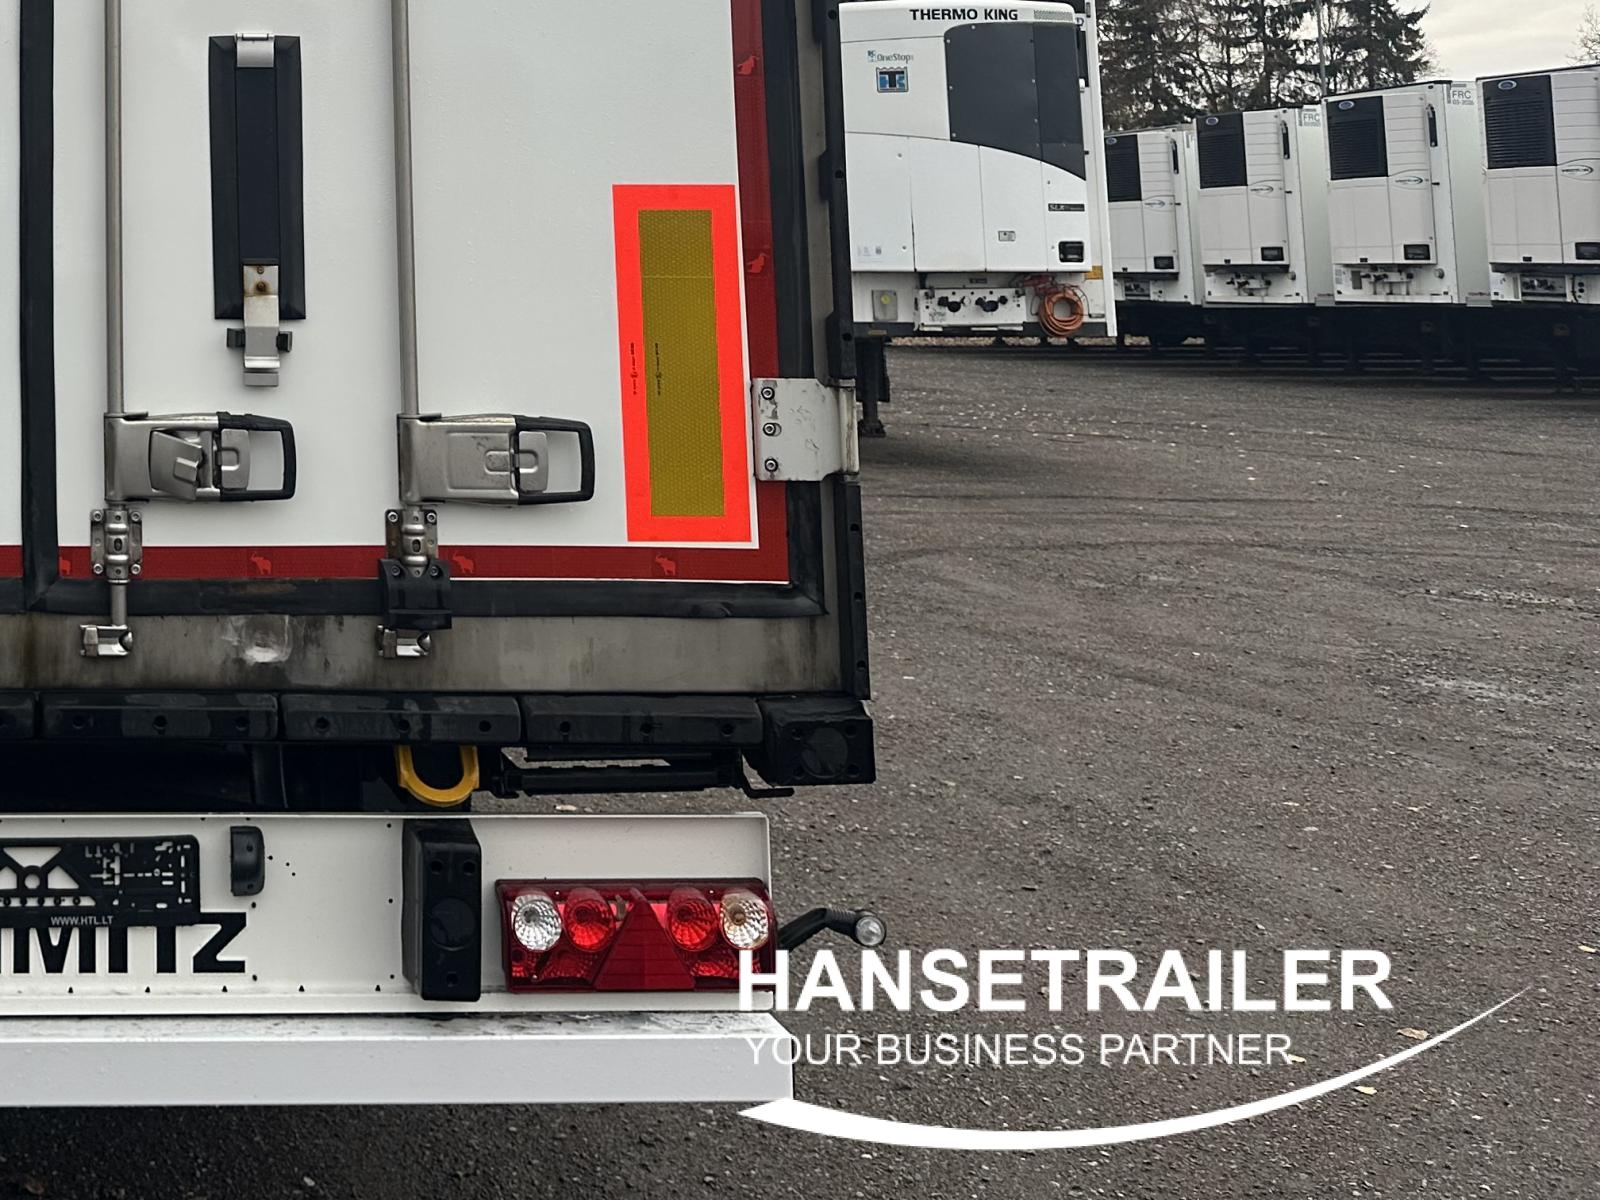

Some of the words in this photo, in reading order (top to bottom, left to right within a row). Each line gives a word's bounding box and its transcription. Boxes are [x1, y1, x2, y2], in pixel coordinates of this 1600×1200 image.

[909, 8, 978, 21] THERMO
[984, 8, 1018, 21] KING
[1452, 90, 1472, 99] FRC
[50, 915, 114, 926] WWW.HTL.LT
